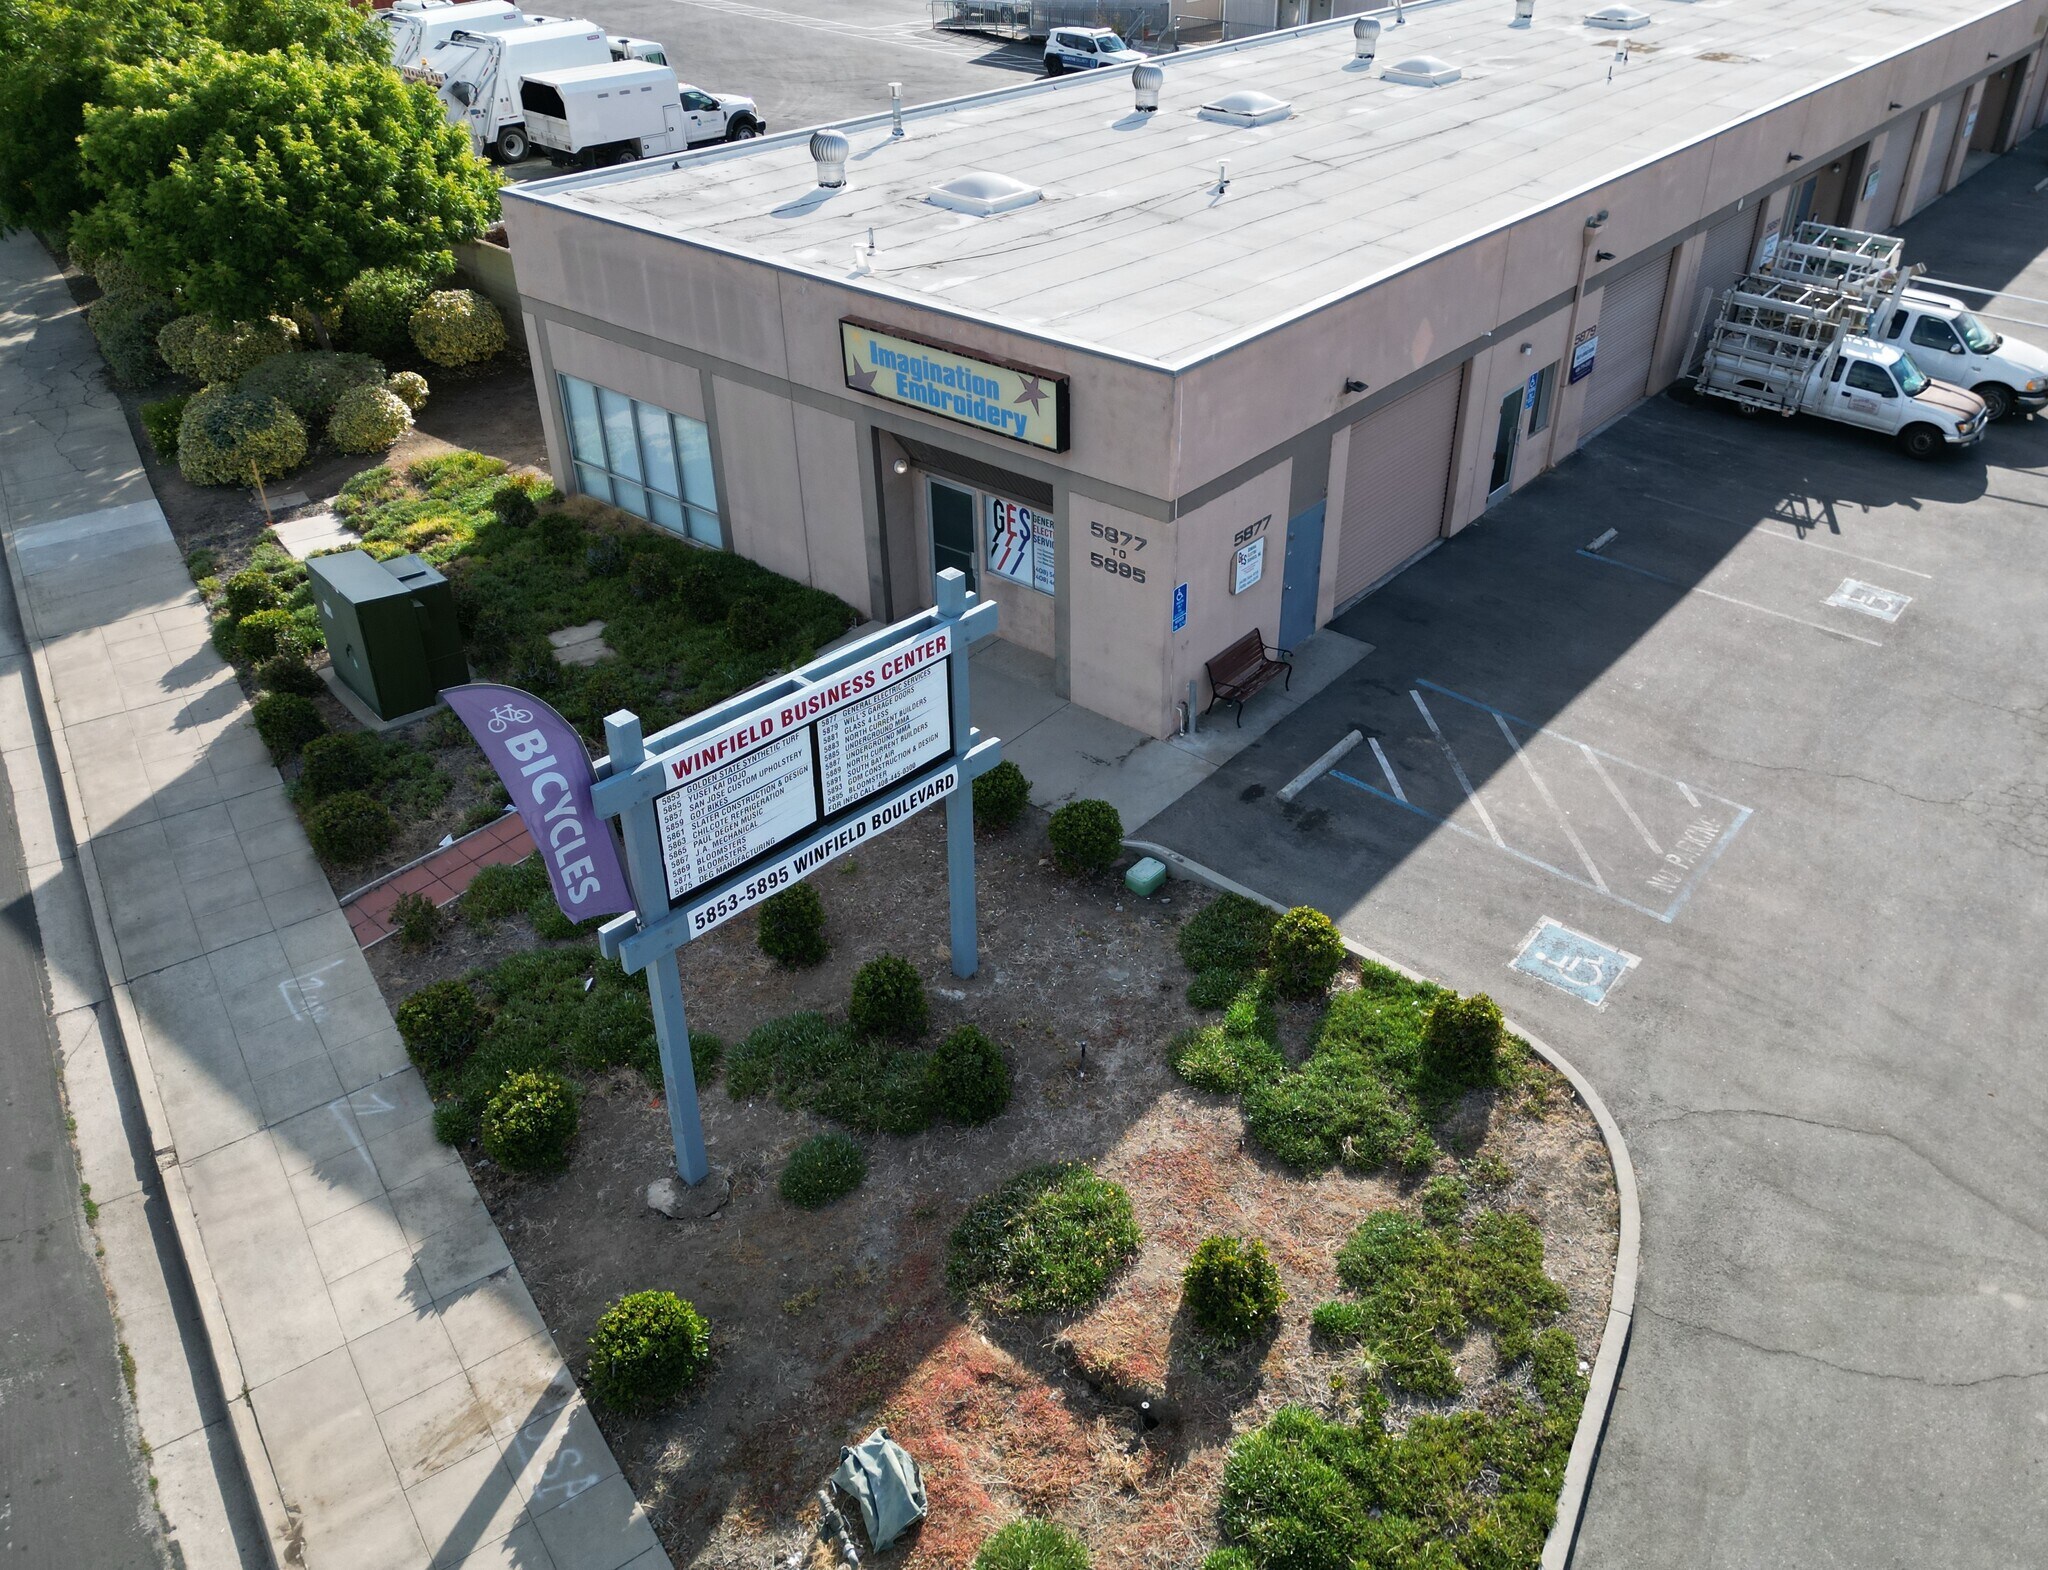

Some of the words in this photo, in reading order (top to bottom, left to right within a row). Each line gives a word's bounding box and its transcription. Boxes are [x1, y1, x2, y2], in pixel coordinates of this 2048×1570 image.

[1575, 325, 1596, 345] 5879
[870, 340, 999, 400] Imagination
[896, 372, 1027, 437] Embroidery
[1033, 524, 1054, 538] ELECT
[1091, 521, 1147, 551] 5877
[1111, 547, 1126, 559] TO
[1234, 514, 1272, 547] 5877
[1091, 552, 1145, 583] 5895
[672, 717, 772, 779] WINFIELD
[781, 670, 876, 728] BUSINESS
[881, 636, 946, 680] CENTER
[821, 715, 837, 727] 5877
[843, 698, 872, 717] GENERAL
[874, 682, 901, 702] ELECTRIC
[904, 668, 931, 687] SERVICES
[823, 724, 838, 736] 5879
[844, 712, 866, 725] WILL'S
[868, 697, 893, 714] GARAGE
[894, 687, 914, 702] DOORS
[823, 733, 839, 744] 5881
[845, 721, 865, 734] GLASS
[874, 709, 889, 721] LESS
[824, 741, 840, 753] 5883
[845, 729, 867, 743] NORTH
[869, 714, 897, 731] CURRENT
[899, 697, 927, 716] BUILDERS
[825, 750, 840, 761] 5885
[845, 723, 893, 751] UNDERGROUND
[895, 715, 910, 727] MMA
[825, 758, 840, 770] 5887
[846, 731, 894, 760] UNDERGROUND
[897, 724, 911, 736] MMA
[662, 792, 681, 805] 5853
[687, 775, 717, 793] GOLDEN
[720, 765, 740, 780] STATE
[743, 743, 780, 767] SYNTHETIC
[783, 734, 800, 749] TURF
[826, 767, 841, 778] 5889
[847, 754, 868, 769] NORTH
[871, 739, 898, 758] CURRENT
[901, 723, 928, 741] BUILDERS
[827, 777, 842, 787] 5891
[848, 762, 869, 778] SOUTH
[871, 756, 882, 766] BAY
[885, 750, 895, 759] AIR
[828, 784, 842, 796] 5893
[865, 748, 911, 776] CONSTRUCTION
[918, 732, 939, 748] DESIGN
[664, 801, 682, 814] 5855
[688, 788, 711, 802] YUSEI
[714, 782, 725, 791] KAI
[728, 771, 746, 785] DOJO
[665, 810, 683, 823] 5857
[690, 801, 704, 811] SAN
[707, 790, 725, 805] JOSE
[728, 774, 757, 794] CUSTOM
[760, 750, 803, 778] UPHOLSTERY
[667, 829, 685, 842] 5861
[692, 812, 719, 830] SLATER
[722, 784, 776, 815] CONSTRUCTION
[785, 765, 808, 783] DESIGN
[828, 792, 843, 804] 5895
[849, 770, 887, 793] BLOOMSTER
[828, 802, 841, 812] FOR
[843, 792, 858, 804] INFO
[860, 786, 875, 799] CALL
[504, 729, 600, 904] BICYCLES
[666, 820, 684, 832] 5859
[690, 810, 704, 821] GOT
[708, 798, 728, 814] BIKES
[668, 838, 686, 851] 5863
[693, 818, 728, 839] CHILCOTE
[731, 788, 784, 821] REFRIGERATION
[669, 847, 687, 860] 5865
[694, 836, 712, 848] PAUL
[715, 821, 738, 837] DEGEN
[745, 809, 763, 823] MUSIC
[671, 856, 688, 868] 5867
[696, 845, 709, 856] J.A.
[712, 821, 758, 848] MECHANICAL
[672, 865, 690, 878] 5869
[697, 836, 746, 865] BLOOMSTERS
[674, 874, 691, 886] 5871
[698, 845, 747, 874] BLOOMSTERS
[675, 882, 693, 895] 5875
[699, 871, 714, 882] DEG
[716, 837, 775, 874] MANUFACTURING
[695, 867, 789, 930] 5853-5895
[793, 822, 865, 874] WINFIELD
[872, 774, 954, 829] BOULEVARD
